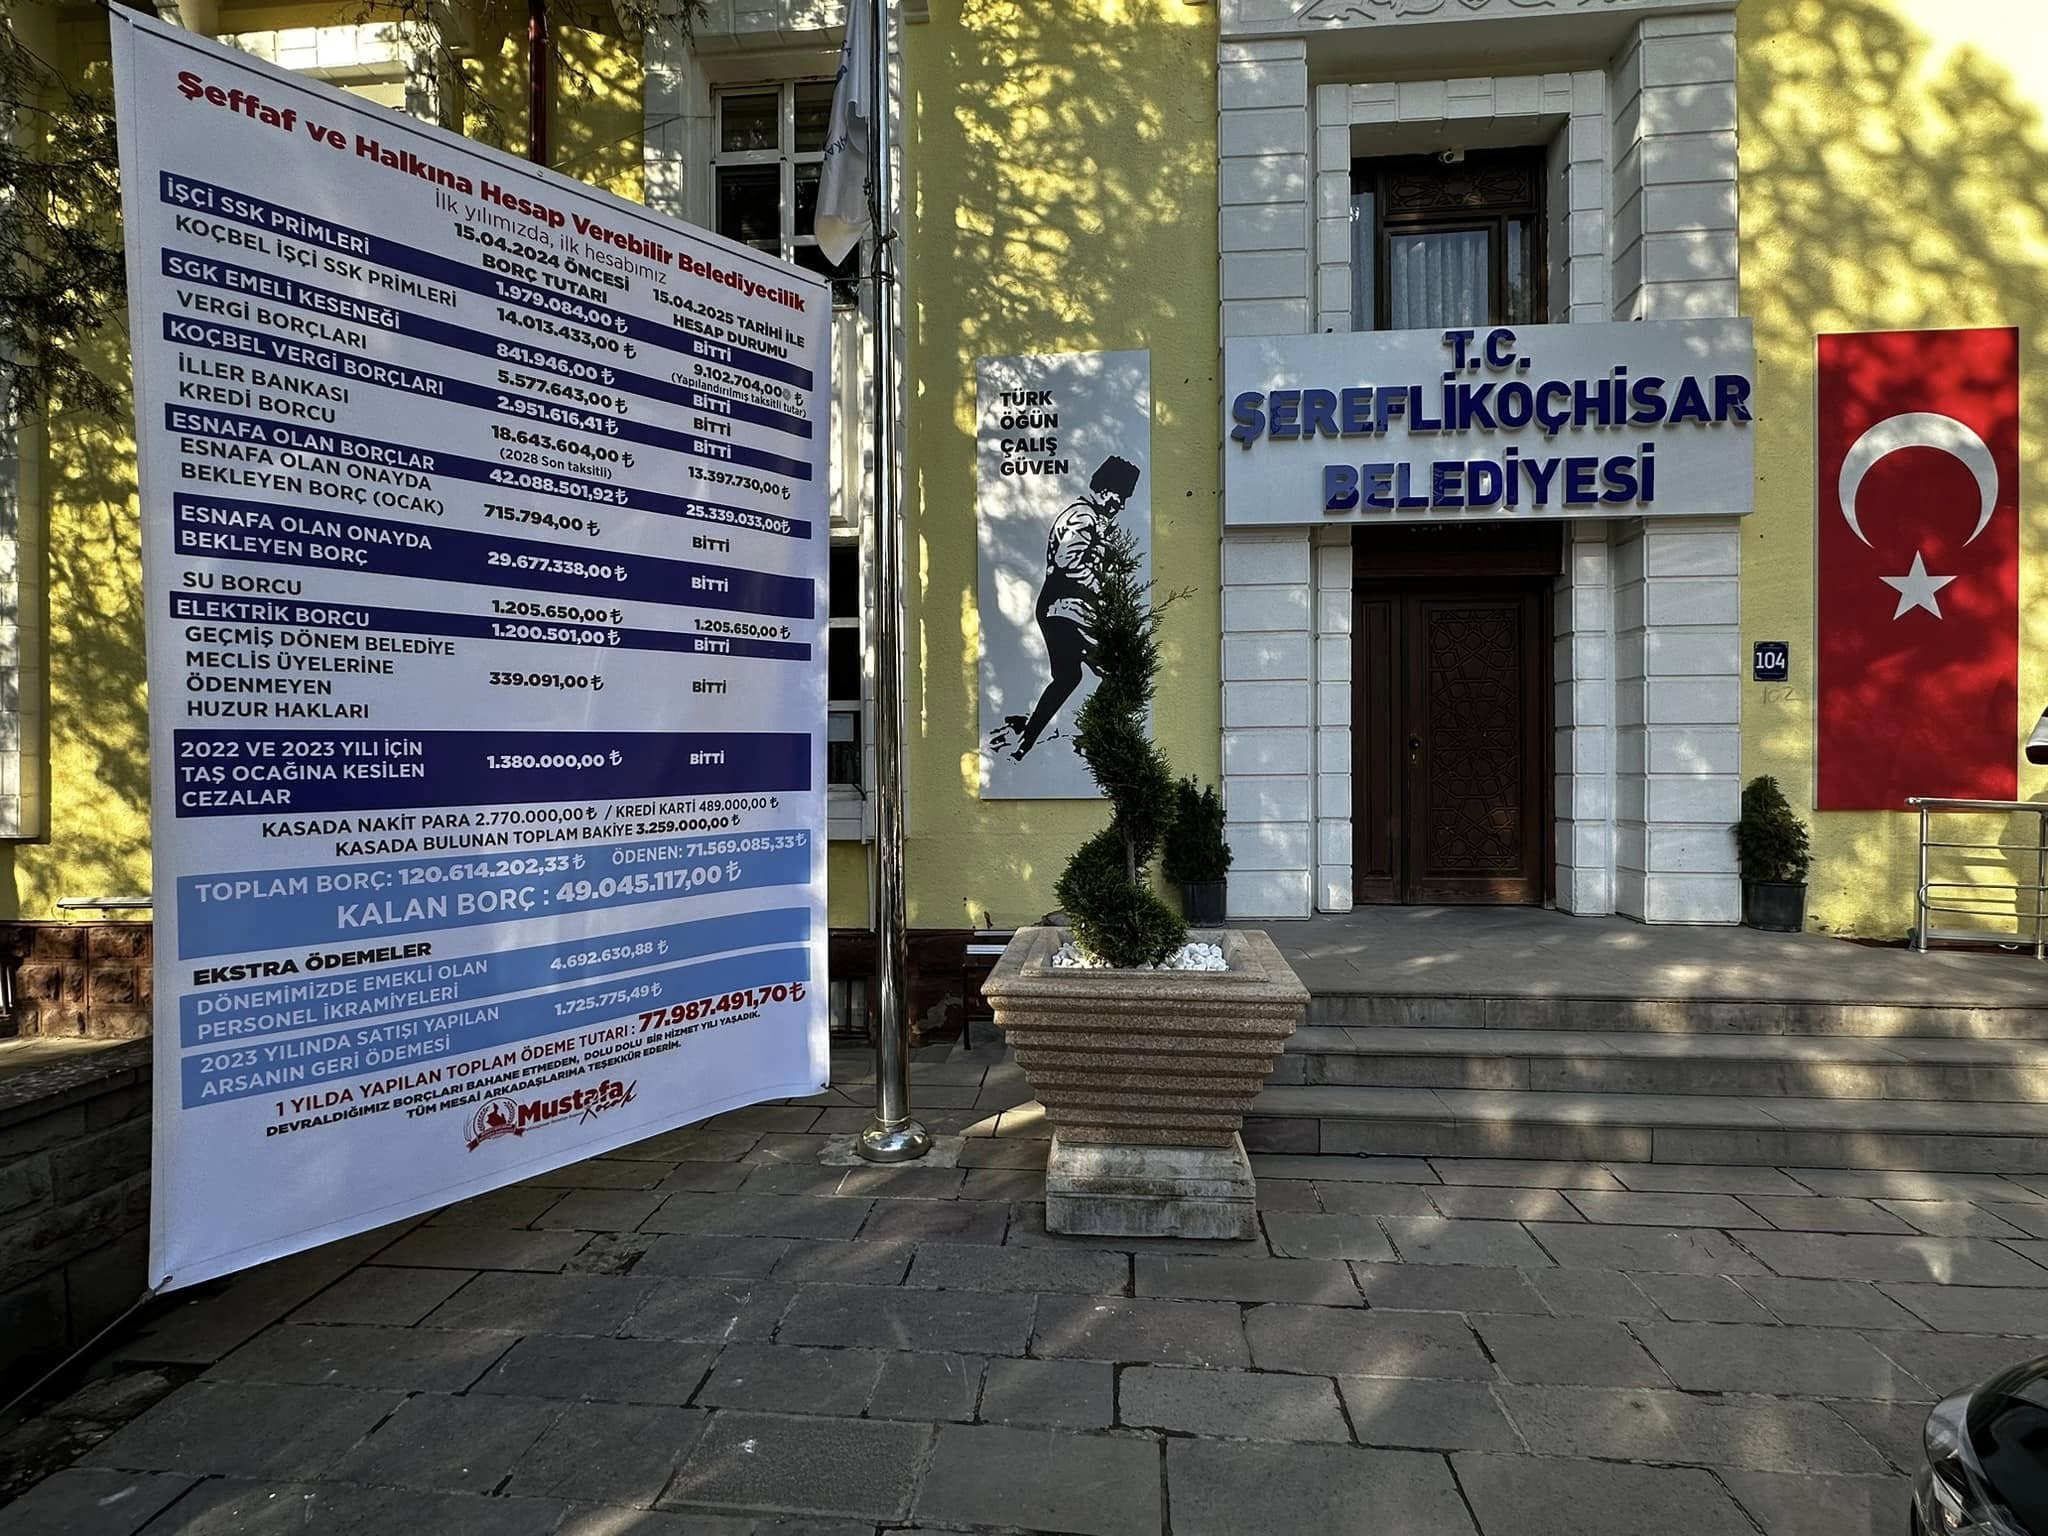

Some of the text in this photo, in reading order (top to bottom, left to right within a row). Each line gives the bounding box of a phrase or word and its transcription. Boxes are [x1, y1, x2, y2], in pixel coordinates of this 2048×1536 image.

[177, 71, 807, 313] Şeffaf ve Halkına Hesap Verebilir Belediyecilik
[176, 214, 270, 255] KOÇBEL
[277, 239, 317, 268] İŞÇİ
[323, 257, 363, 282] SSK
[368, 269, 457, 308] PRİMLERİ
[435, 187, 667, 285] İlk yılımızda, ilk hesabımız
[454, 222, 630, 291] 15.04.2024 ÖNCESİ
[167, 177, 731, 362] İŞÇİ SSK PRİMLERİ BİTTİ
[482, 253, 607, 304] BORÇ TUTARI
[169, 257, 731, 415] SGK EMELİ KESENEĞİ BİTTİ
[653, 288, 805, 348] 15.04.2025 TARİHİ İLE
[673, 314, 787, 359] HESAP DURUMU
[177, 290, 731, 436] VERGİ BORÇLARI BİTTİ
[1442, 328, 1531, 372] T.C.
[170, 320, 731, 459] KOÇBEL VERGİ BORÇLARI BİTTİ
[179, 352, 349, 403] İLLER BANKASI
[179, 381, 251, 408] KREDİ
[259, 394, 336, 423] BORCU
[1000, 387, 1053, 407] TÜRK
[1000, 410, 1058, 430] ÖĞÜN
[1229, 365, 1753, 449] ŞEREFLİKOÇHİSAR
[172, 411, 435, 471] ESNAFA OLAN BORÇLAR
[180, 437, 432, 491] ESNAFA OLAN ONAYDA
[500, 447, 538, 465] (2028
[542, 456, 564, 470] Son
[1000, 437, 1057, 458] ÇALIŞ
[1000, 456, 1068, 476] GÜVEN
[1322, 442, 1655, 513] BELEDİYESİ
[181, 462, 302, 493] BEKLEYEN
[309, 480, 366, 505] BORÇ
[373, 490, 444, 516] (OCAK)
[692, 535, 730, 552] BİTTİ
[181, 505, 433, 550] ESNAFA OLAN ONAYDA
[182, 530, 729, 593] BEKLEYEN BORÇ BİTTİ
[183, 571, 213, 589] SU
[221, 573, 302, 596] BORCU
[177, 599, 730, 653] ELEKTRİK BORCU BİTTİ
[185, 626, 455, 656] GEÇMİŞ DÖNEM BELEDİYE
[186, 650, 270, 670] MECLİS
[277, 652, 394, 675] ÜYELERİNE
[692, 679, 726, 694] BİTTİ
[186, 672, 332, 695] ÖDENMEYEN
[1756, 652, 1785, 669] 104
[187, 700, 369, 719] HUZUR HAKLARI
[180, 738, 423, 758] 2022 VE 2023 YILI İÇİN
[181, 765, 226, 784] TAŞ
[232, 762, 337, 782] OCAĞINA
[343, 760, 425, 779] KESİLEN
[690, 750, 724, 765] BİTTİ
[182, 789, 291, 807] CEZALAR
[262, 819, 352, 838] KASADA
[358, 814, 416, 833] NAKİT
[422, 813, 470, 829] PARA
[616, 802, 656, 818] KREDİ
[335, 822, 633, 857] KASADA BULUNAN TOPLAM BAKİYE
[195, 877, 309, 903] TOPLAM
[317, 870, 392, 893] BORÇ:
[612, 845, 683, 865] ÖDENEN:
[337, 895, 447, 929] KALAN
[458, 887, 535, 916] BORÇ
[193, 942, 432, 986] EKSTRA ÖDEMELER
[197, 960, 487, 1016] DÖNEMİMİZDE EMEKLİ OLAN
[198, 982, 458, 1040] PERSONEL İKRAMİYELERİ
[201, 1007, 499, 1074] 2023 YILINDA SATIŞI YAPILAN
[201, 1034, 450, 1098] ARSANIN GERİ ÖDEMESİ
[266, 1101, 390, 1137] DEVRALDIĞIMIZ
[393, 1083, 463, 1109] BORÇLARI
[466, 1070, 520, 1091] BAHANE
[522, 1056, 580, 1077] ETMEDEN,
[584, 1046, 613, 1060] DOLU
[615, 1038, 642, 1053] DOLU
[647, 1033, 663, 1044] BİR
[664, 1025, 699, 1040] HİZMET
[701, 1020, 718, 1030] YILI
[291, 1025, 628, 1112] YILDA YAPILAN TOPLAM ÖDEME TUTARI
[406, 1103, 437, 1120] TÜM
[439, 1091, 480, 1111] MESAİ
[484, 1066, 586, 1098] ARKADAŞLARIMA
[588, 1048, 641, 1072] TEŞEKKÜR
[518, 1079, 624, 1127] Mustafa
